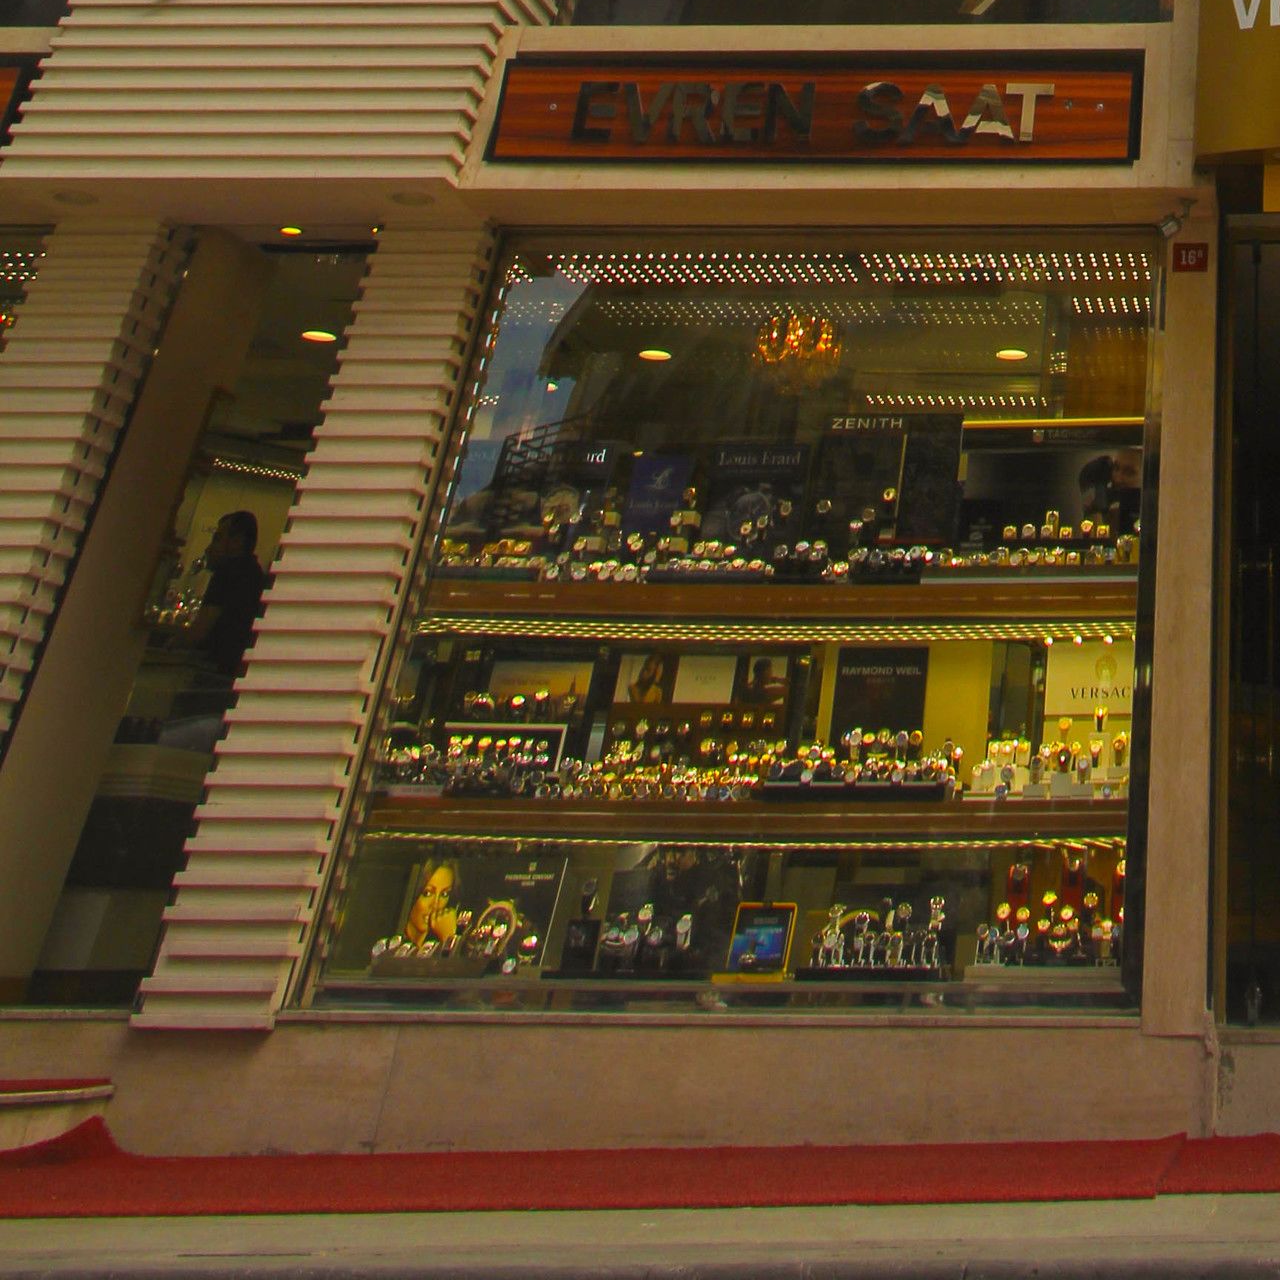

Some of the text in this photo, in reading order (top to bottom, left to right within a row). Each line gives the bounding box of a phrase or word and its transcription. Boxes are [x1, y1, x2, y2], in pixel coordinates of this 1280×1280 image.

[570, 81, 1056, 143] EVREN SAAT
[831, 417, 904, 430] ZENITH
[841, 666, 922, 676] RAYMOND WEIL
[1070, 686, 1131, 700] VERSAC
